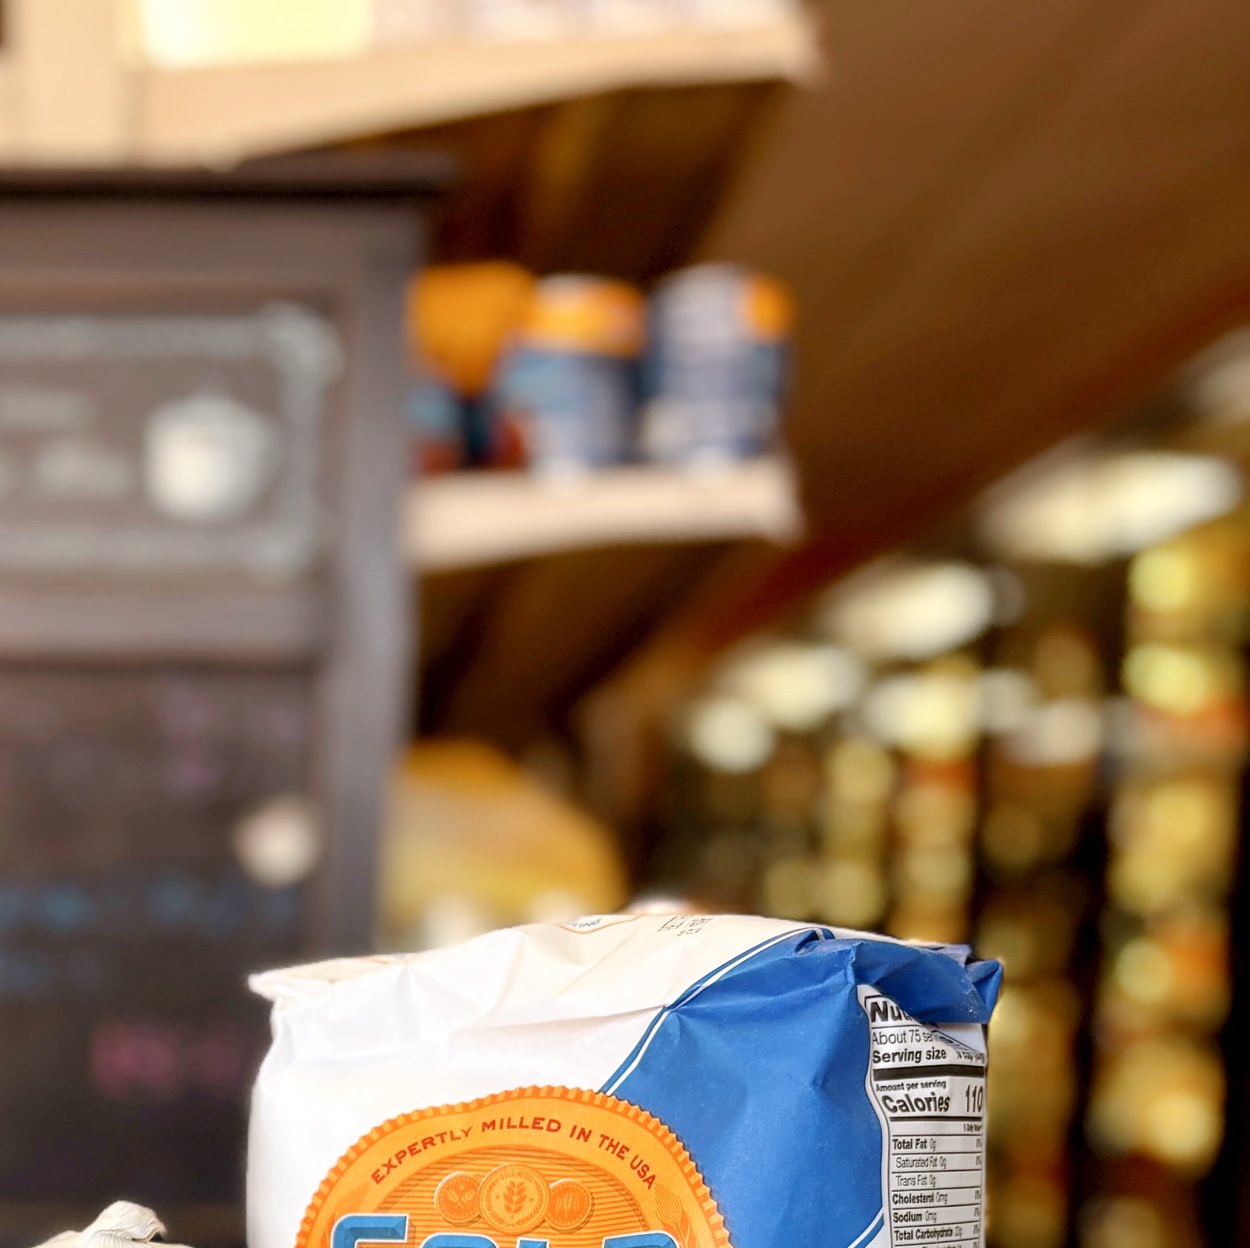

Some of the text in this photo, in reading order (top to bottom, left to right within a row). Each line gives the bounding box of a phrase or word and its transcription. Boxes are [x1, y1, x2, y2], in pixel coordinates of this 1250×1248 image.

[872, 1030, 907, 1045] About
[909, 1029, 921, 1043] 75
[872, 1049, 922, 1064] Serving
[925, 1047, 947, 1061] size
[876, 1080, 947, 1092] Amount per serving
[881, 1092, 950, 1113] Calories
[892, 1138, 928, 1150] Total Fat
[370, 1126, 476, 1186] EXPERTLY
[481, 1116, 562, 1134] MILLED
[569, 1124, 592, 1143] IN
[598, 1133, 631, 1161] THE
[628, 1152, 657, 1190] USA
[893, 1211, 922, 1223] Sodium
